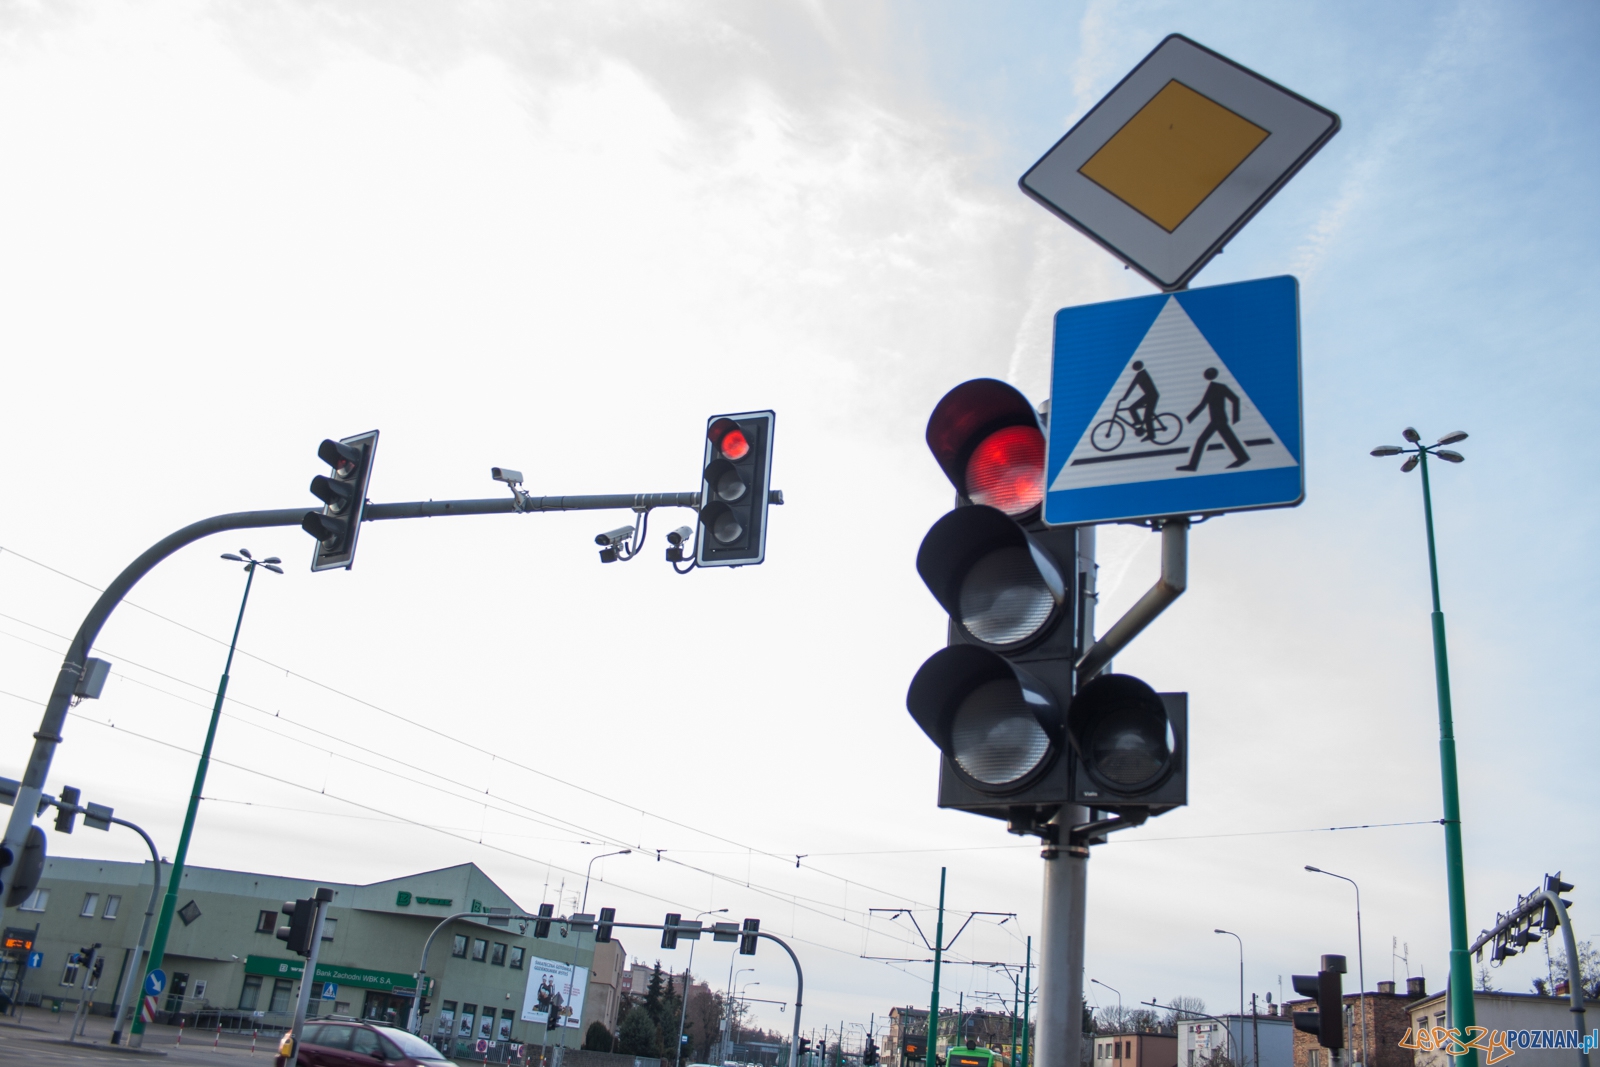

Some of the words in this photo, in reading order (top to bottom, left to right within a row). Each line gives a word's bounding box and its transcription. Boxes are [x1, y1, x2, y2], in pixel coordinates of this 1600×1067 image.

[316, 968, 332, 978] Bank
[332, 971, 362, 981] Zachodni
[362, 975, 379, 983] WBK
[379, 977, 393, 985] S.A.
